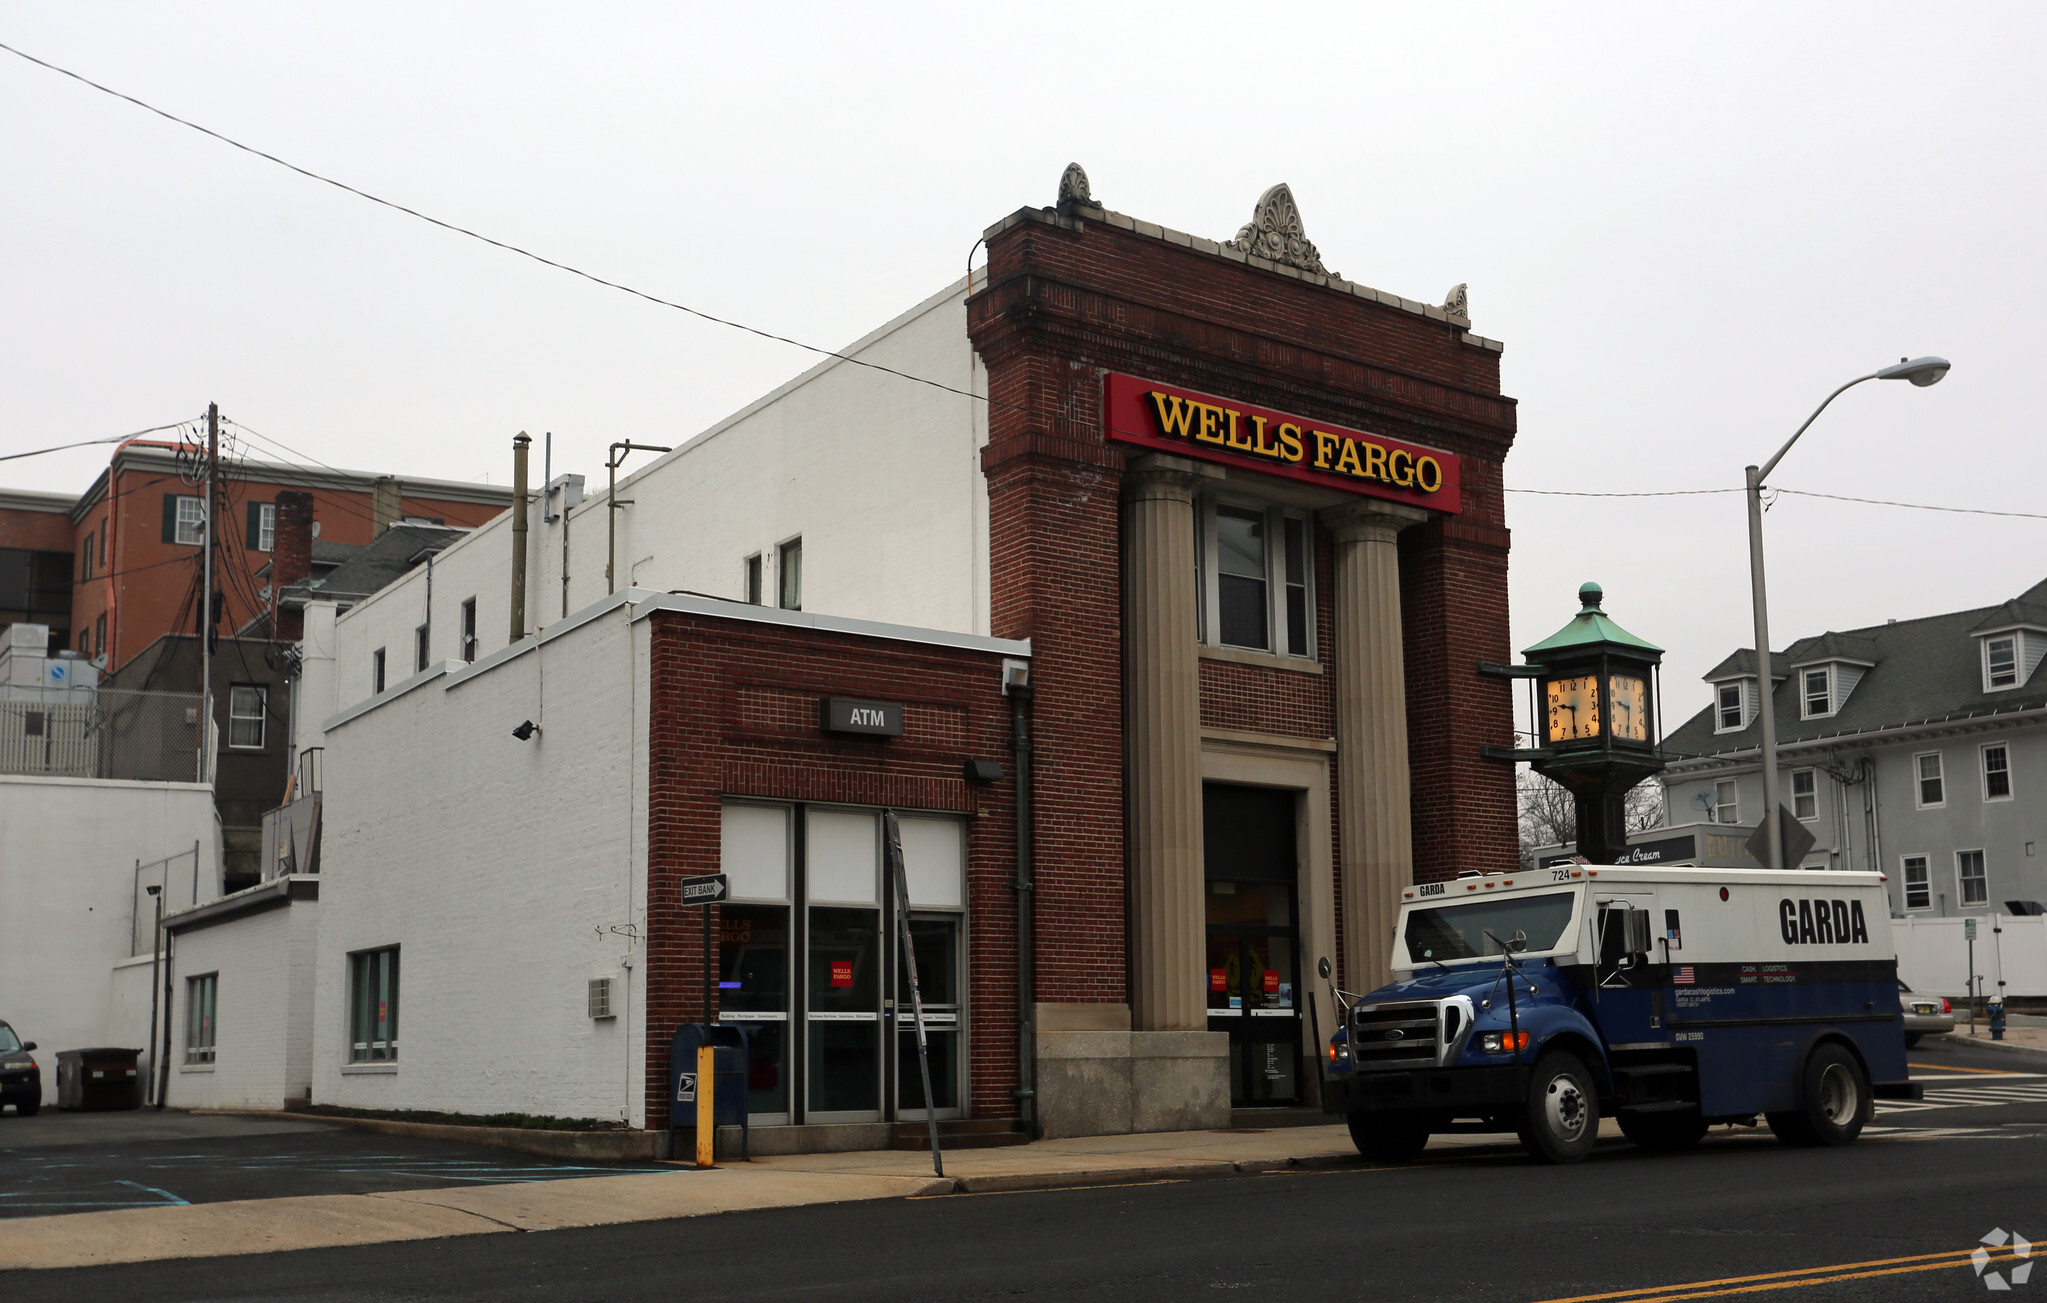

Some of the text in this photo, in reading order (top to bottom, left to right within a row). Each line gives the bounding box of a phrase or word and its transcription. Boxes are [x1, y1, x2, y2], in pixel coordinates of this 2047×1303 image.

[1149, 390, 1444, 494] WELLS FARGO
[1559, 683, 1566, 693] 11
[1570, 682, 1577, 691] 12
[1622, 681, 1628, 691] 12
[1590, 688, 1596, 698] 2
[1552, 694, 1559, 703] 10
[1590, 701, 1596, 710] 3
[1552, 706, 1558, 716] 9
[850, 707, 885, 727] ATM
[1591, 714, 1597, 723] 4
[1553, 719, 1559, 728] 8
[1584, 724, 1590, 733] 5
[1561, 727, 1567, 736] 7
[1632, 848, 1661, 862] Cream
[1552, 869, 1571, 882] 724
[684, 883, 716, 897] EXIT BANK
[1420, 884, 1446, 897] GARDA
[1779, 898, 1869, 945] GARDA
[1675, 987, 1736, 997] gardacashlogistics.com
[1675, 1032, 1688, 1042] GVW
